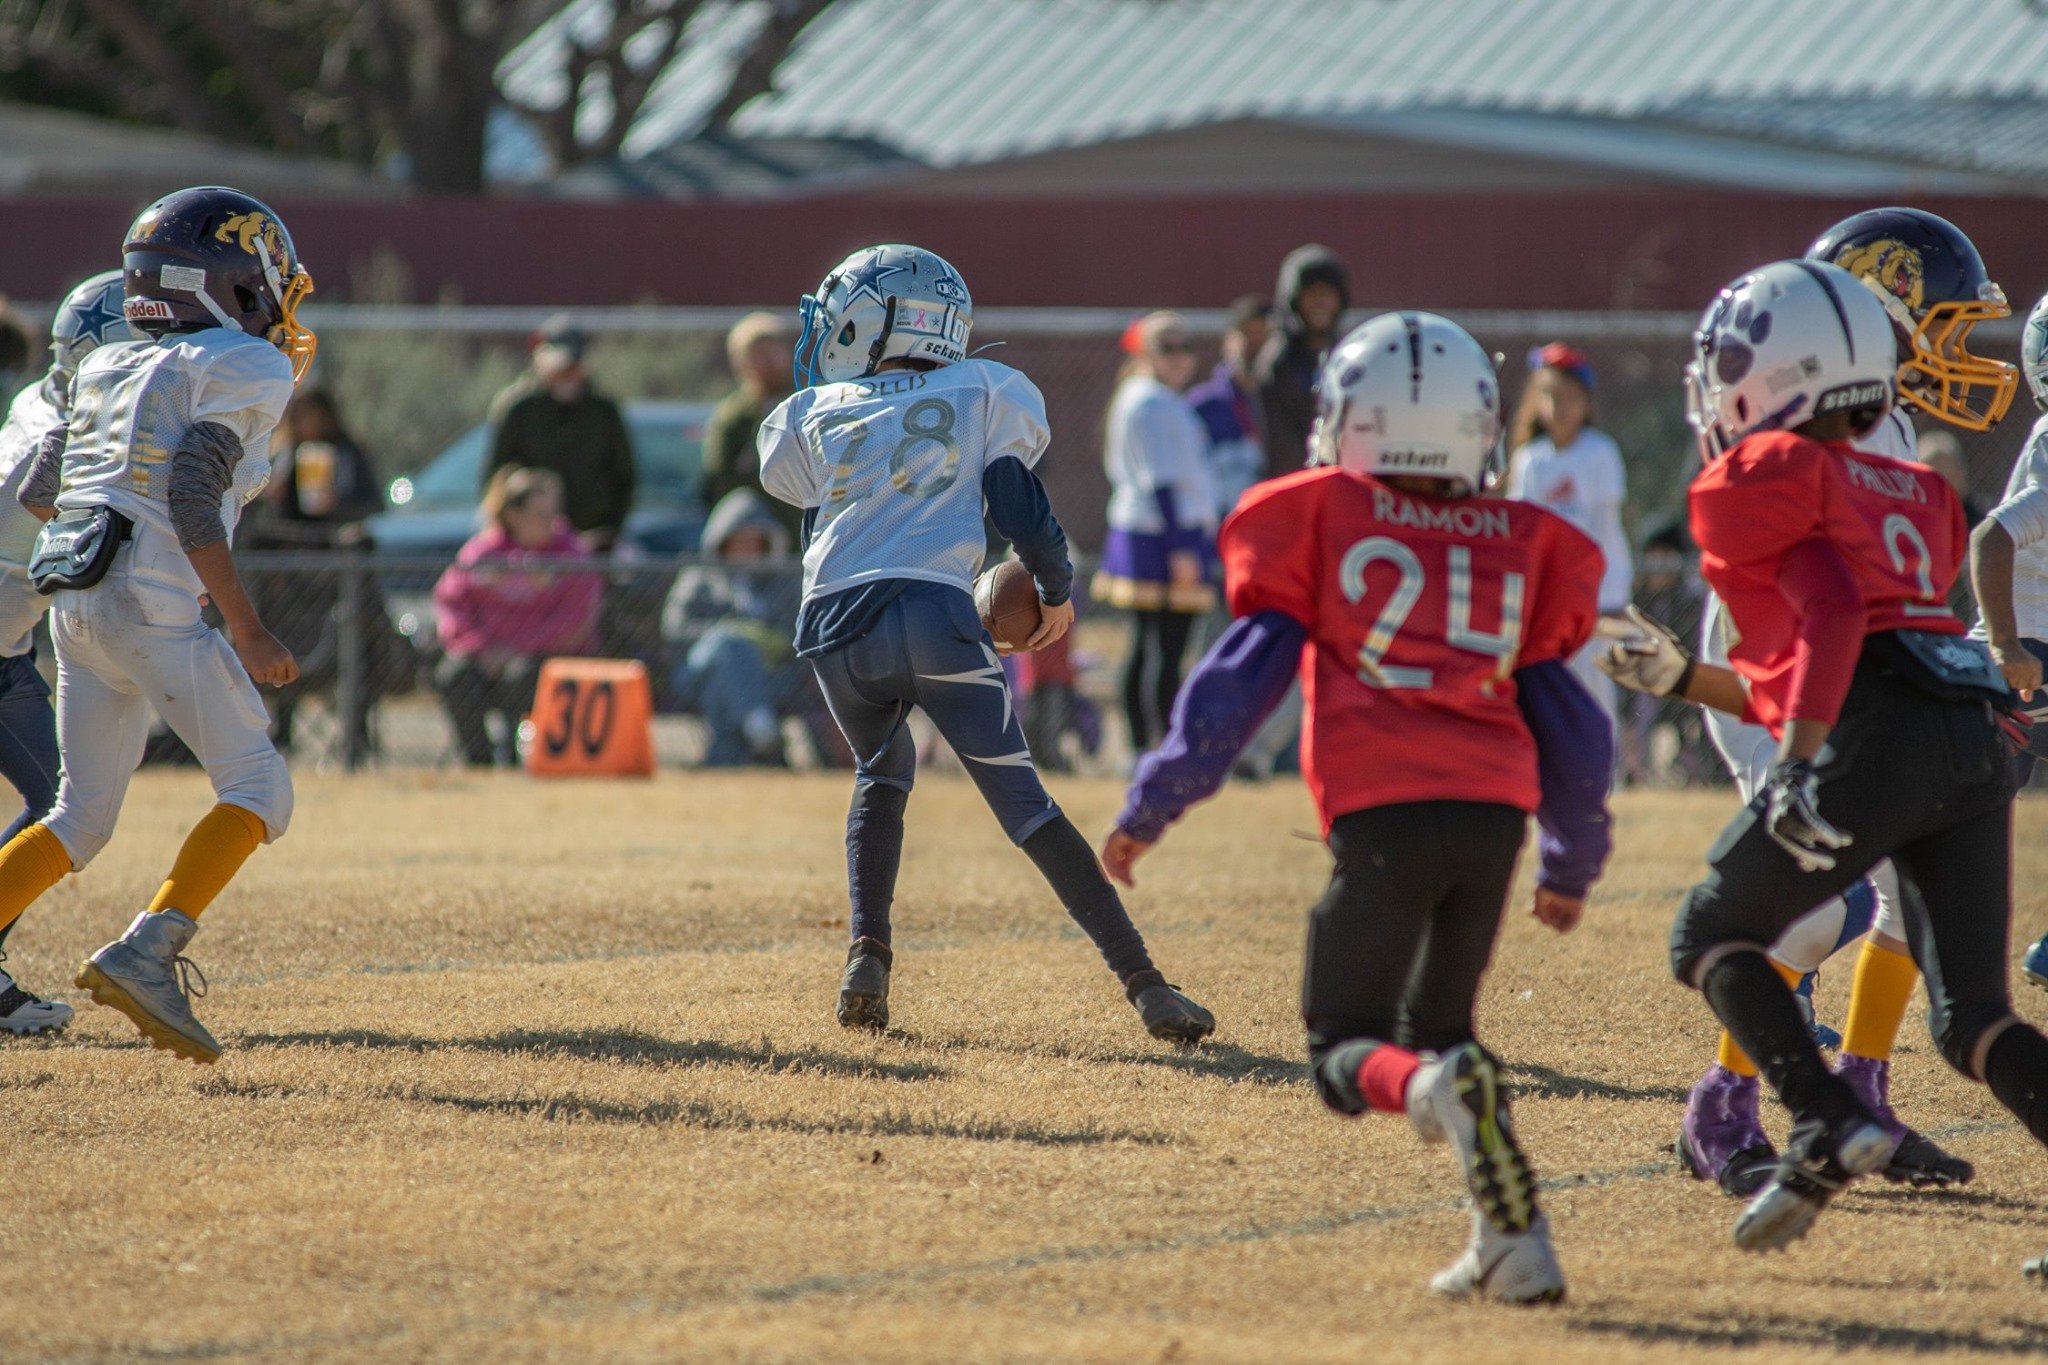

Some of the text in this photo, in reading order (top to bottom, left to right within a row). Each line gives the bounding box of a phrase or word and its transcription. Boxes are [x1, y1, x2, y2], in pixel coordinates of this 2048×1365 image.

[1372, 490, 1511, 538] RAMON
[1339, 535, 1526, 699] 24
[545, 678, 618, 759] 30
